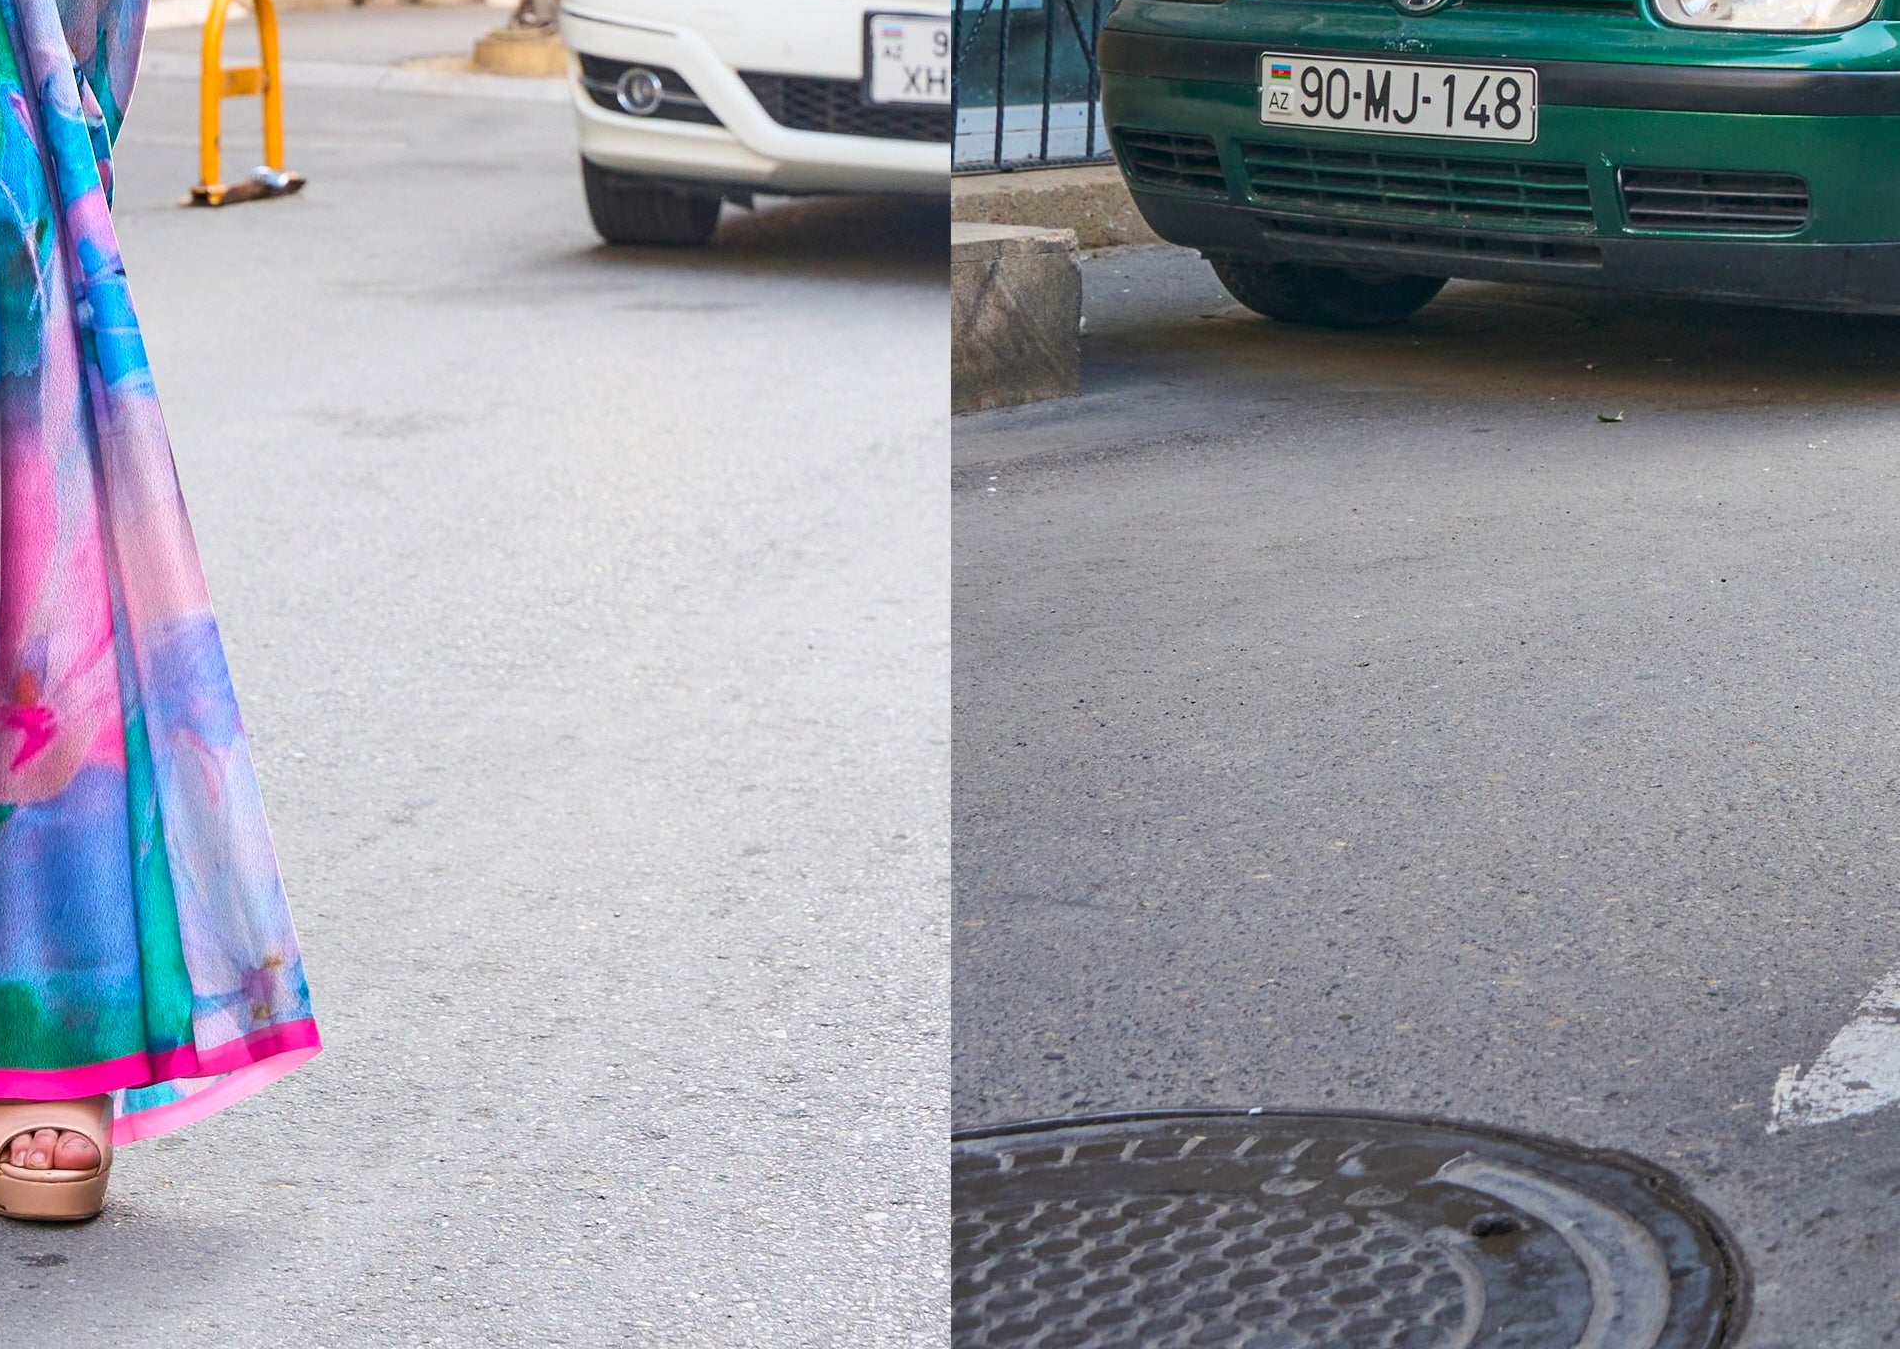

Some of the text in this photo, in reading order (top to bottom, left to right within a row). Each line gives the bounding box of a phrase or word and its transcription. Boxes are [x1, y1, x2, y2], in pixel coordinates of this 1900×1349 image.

[903, 66, 948, 94] XH
[1269, 92, 1289, 111] AZ
[1300, 66, 1522, 130] 90-MJ-148
